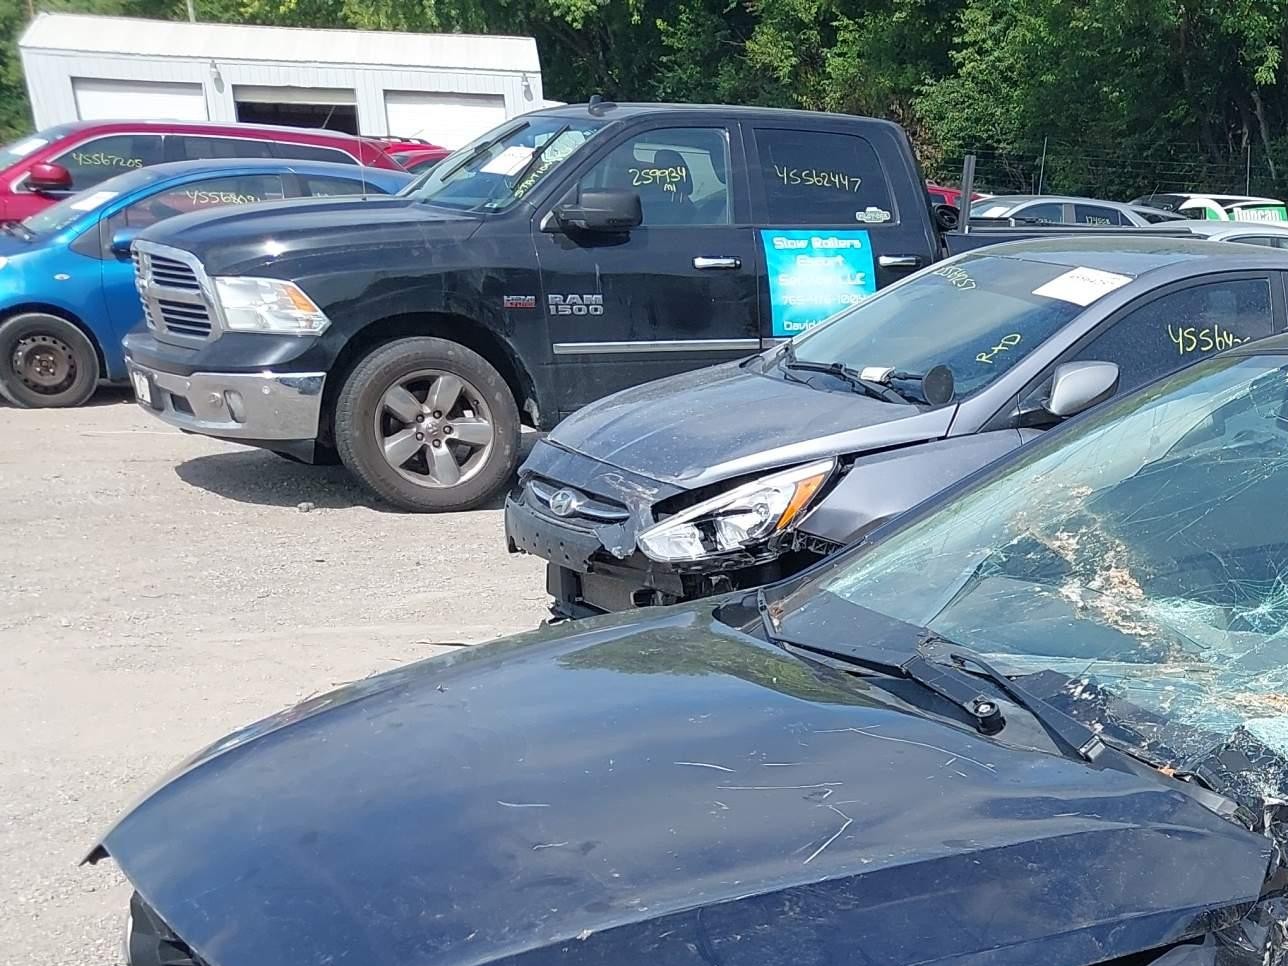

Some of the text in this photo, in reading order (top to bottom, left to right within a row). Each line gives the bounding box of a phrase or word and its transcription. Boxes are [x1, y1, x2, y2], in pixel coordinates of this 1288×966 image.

[72, 152, 143, 168] 45567205
[628, 166, 686, 185] 259934
[774, 164, 862, 192] 45562447
[773, 236, 862, 250] Slow Rollers
[547, 294, 604, 305] RAM
[548, 304, 604, 316] 1500
[1167, 323, 1251, 355] 45564
